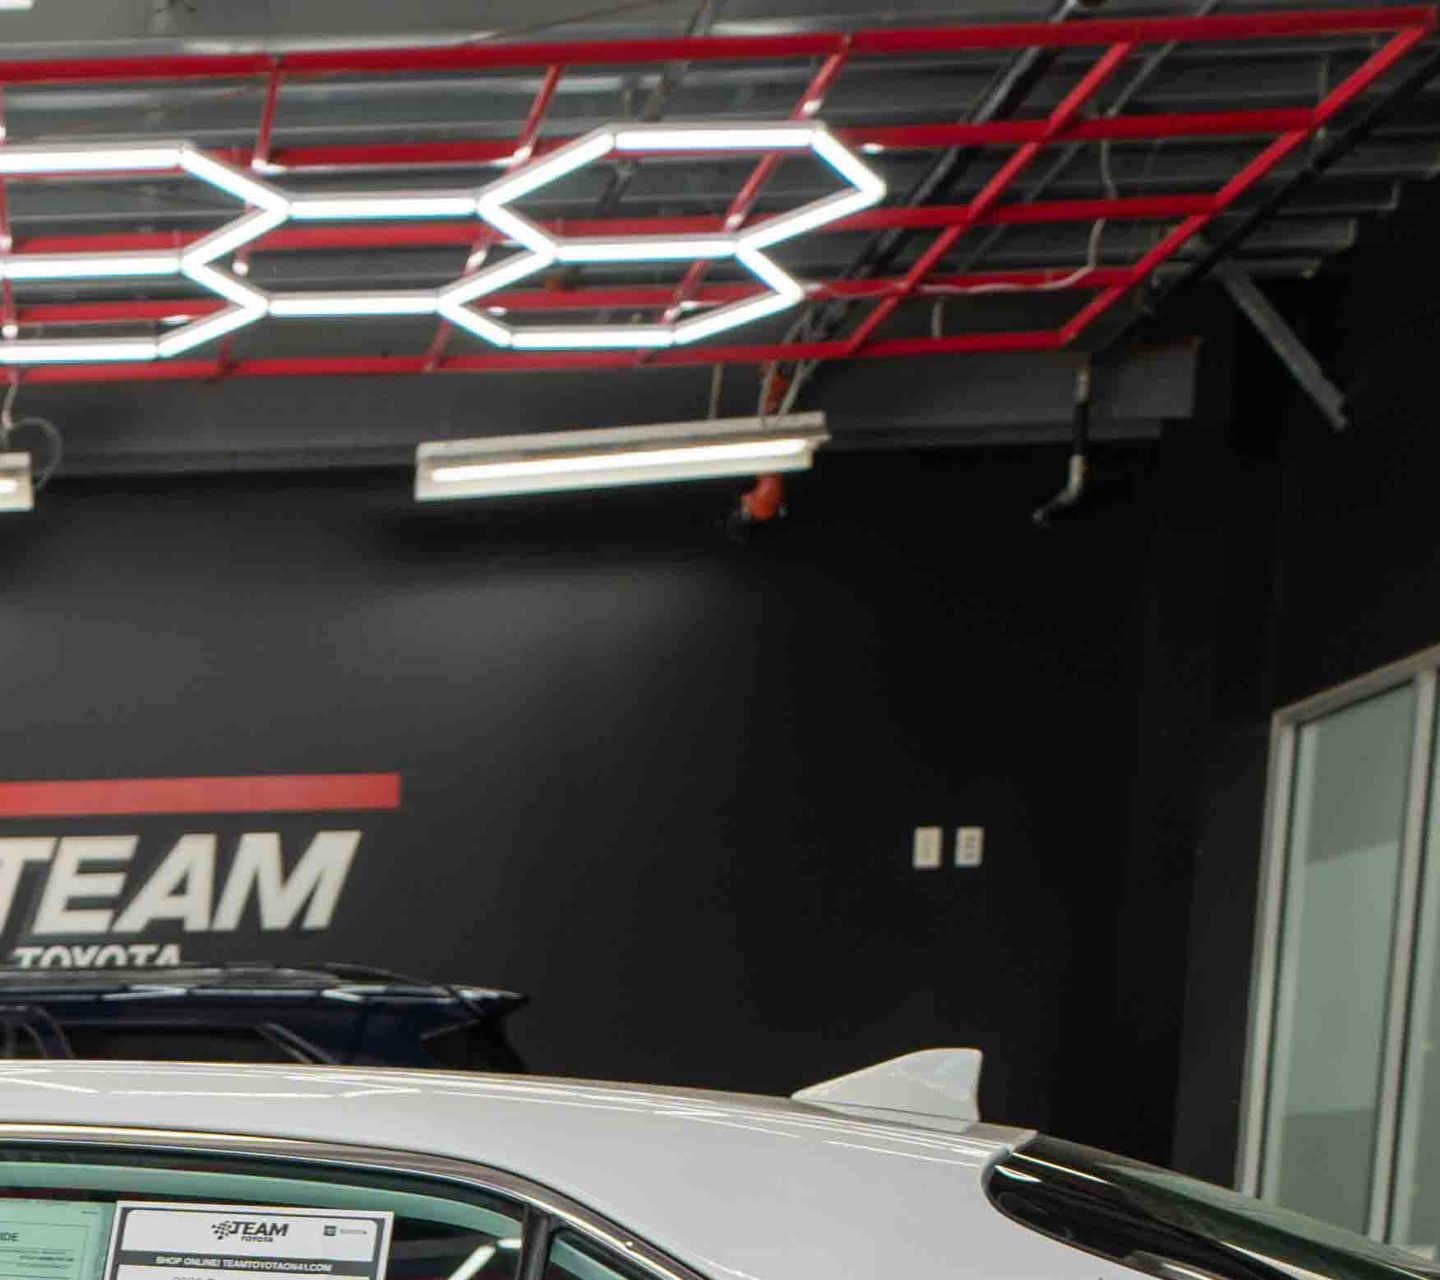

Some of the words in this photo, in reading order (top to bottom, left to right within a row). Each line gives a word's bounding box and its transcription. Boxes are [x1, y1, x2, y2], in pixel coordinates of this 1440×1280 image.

[11, 943, 183, 969] TOYOTA
[229, 1221, 289, 1237] TEAM
[156, 1255, 183, 1266] SHOP
